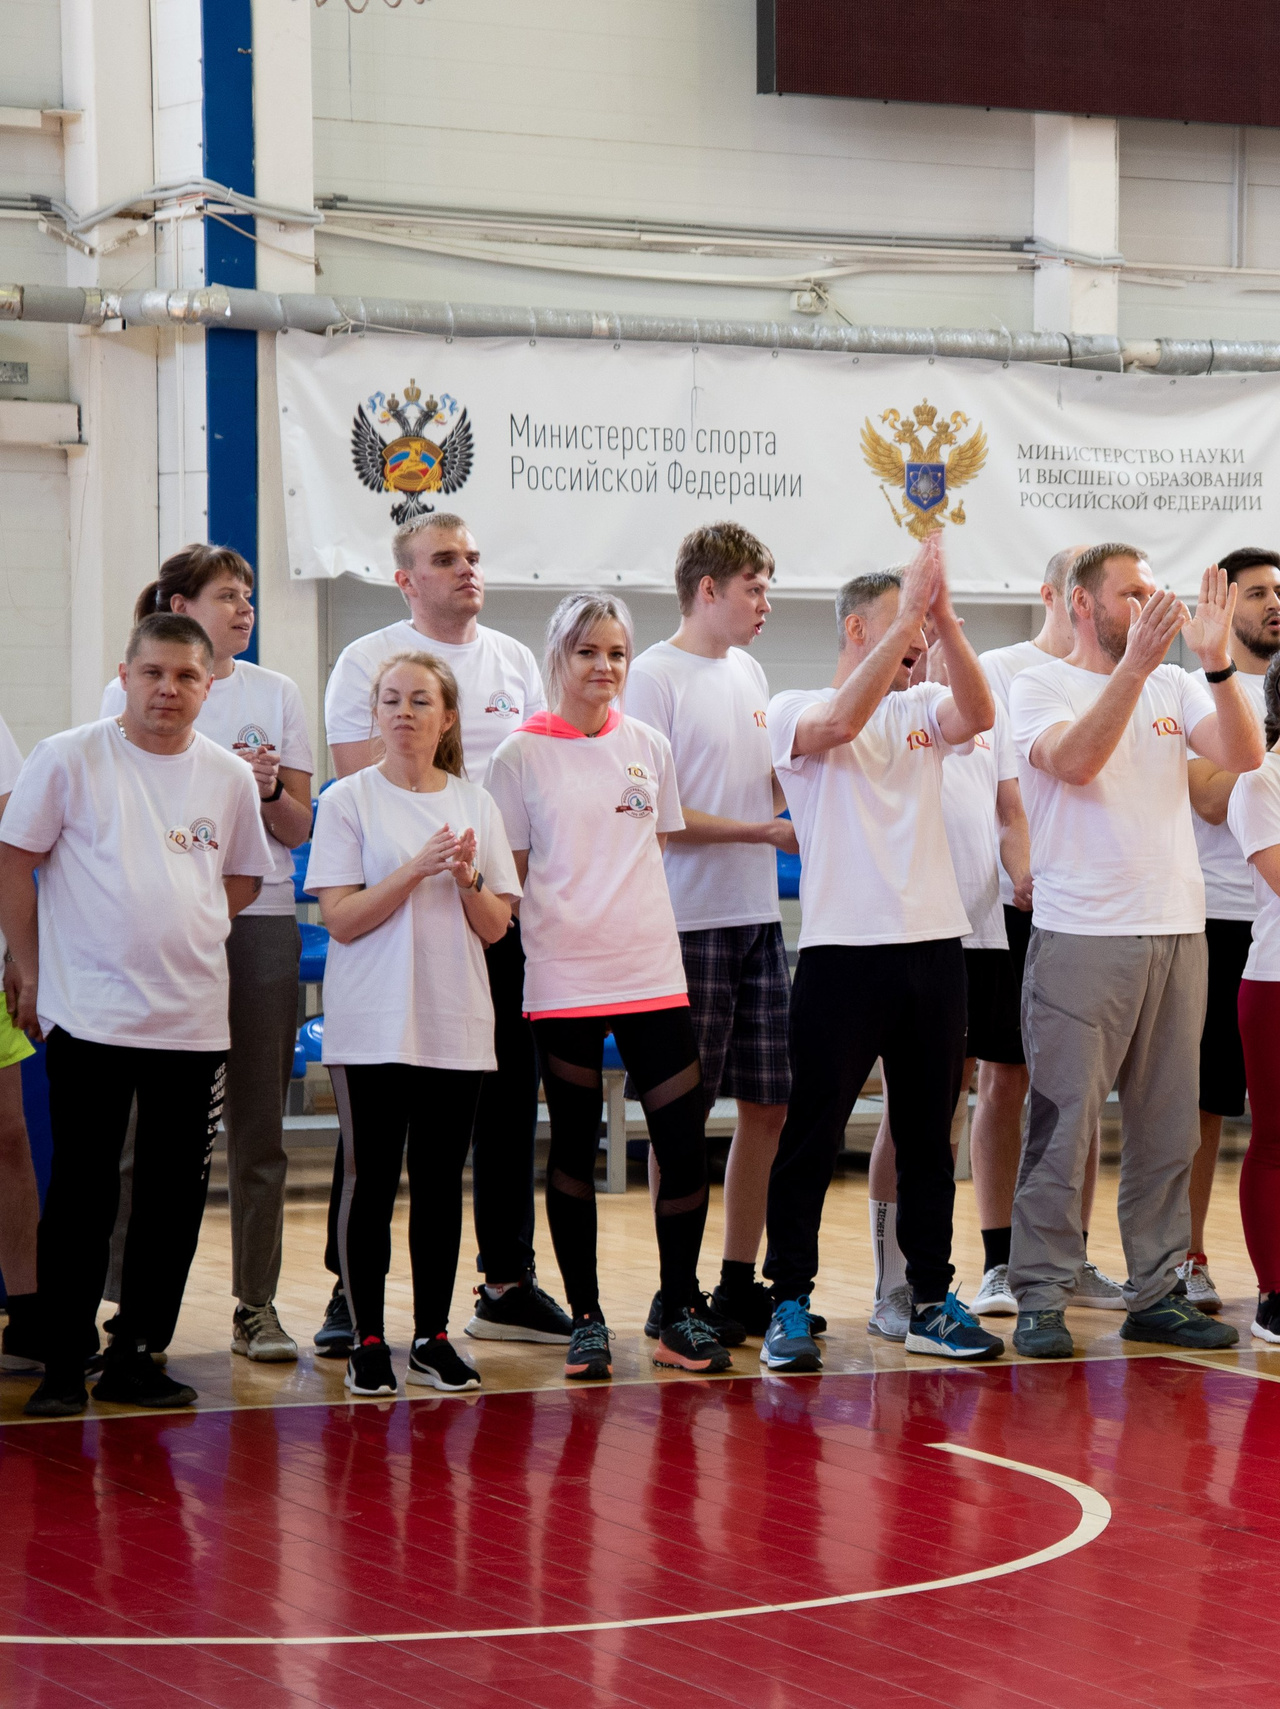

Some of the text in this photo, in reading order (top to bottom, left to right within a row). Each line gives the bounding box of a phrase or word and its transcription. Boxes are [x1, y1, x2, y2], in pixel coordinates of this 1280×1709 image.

[509, 413, 777, 463] Министерство спорта
[1016, 443, 1245, 464] МИНИСТЕРСТВО НАУКИ
[510, 455, 802, 505] Российской Федерации
[1018, 468, 1263, 488] И ВЫСШЕГО ОБРАЗОВАНИЯ
[1020, 490, 1263, 513] РОССИЙСКОЙ ФЕДЕРАЦИИ
